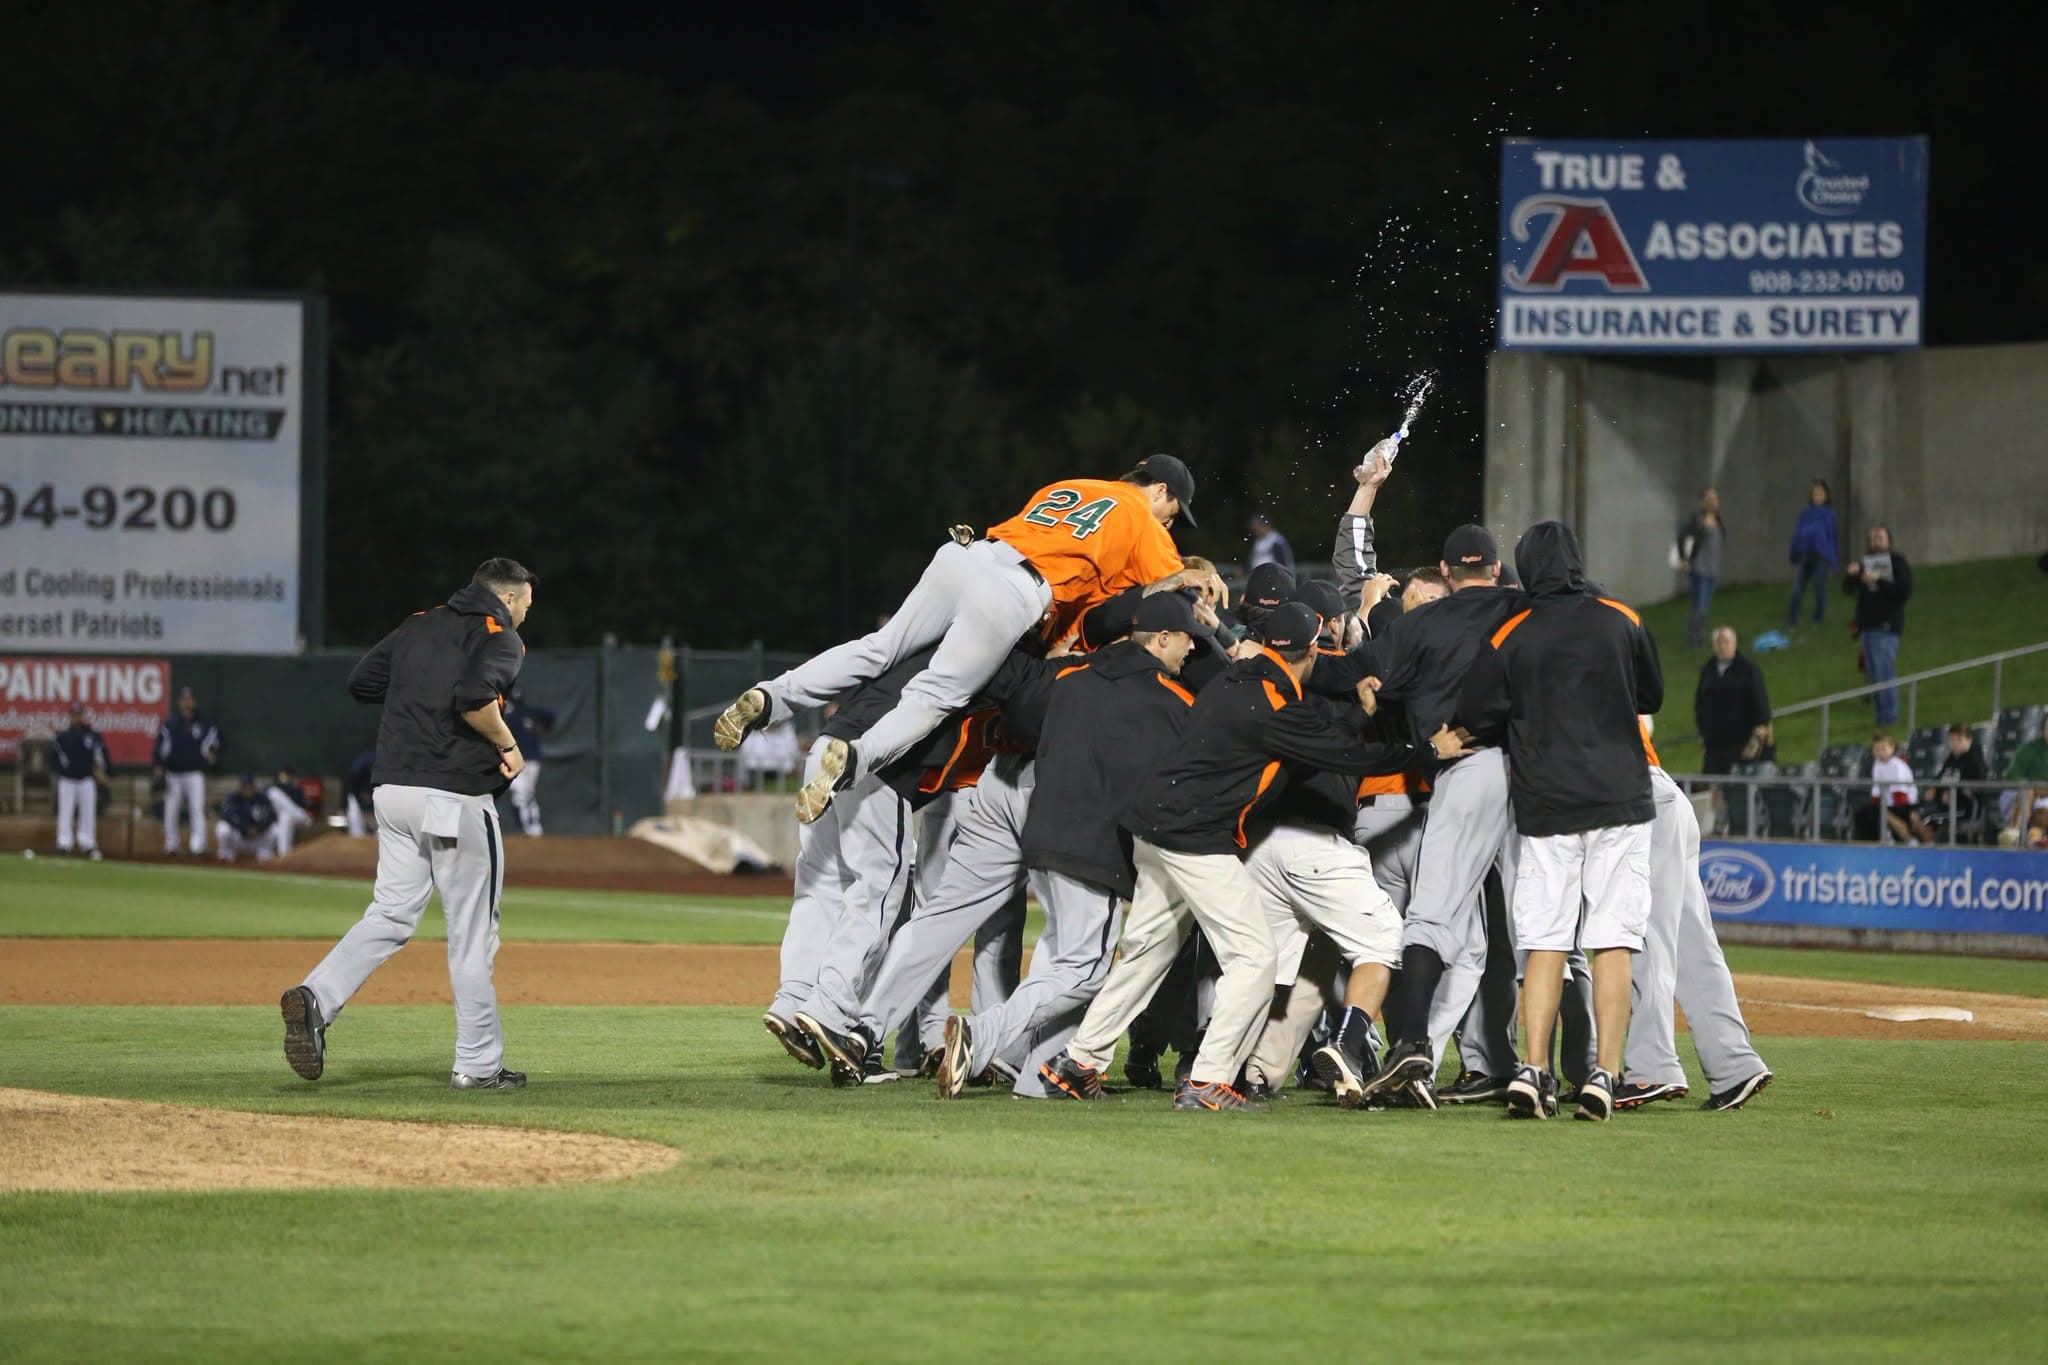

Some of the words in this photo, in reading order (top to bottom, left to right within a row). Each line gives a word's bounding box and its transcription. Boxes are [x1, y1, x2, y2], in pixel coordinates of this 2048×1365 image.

[1534, 152, 1644, 190] TRUE
[1655, 153, 1687, 190] &
[1645, 221, 1903, 260] ASSOCIATES
[1514, 306, 1721, 338] INSURANCE
[1733, 310, 1754, 337] &
[1768, 306, 1911, 338] SURETY
[121, 407, 269, 436] HEATING
[1024, 488, 1117, 540] 24
[25, 567, 114, 602] Cooling
[124, 569, 286, 601] Professionals
[72, 608, 164, 640] Patriots
[1702, 861, 1753, 900] Ford
[1781, 862, 2048, 913] tristateford.com
